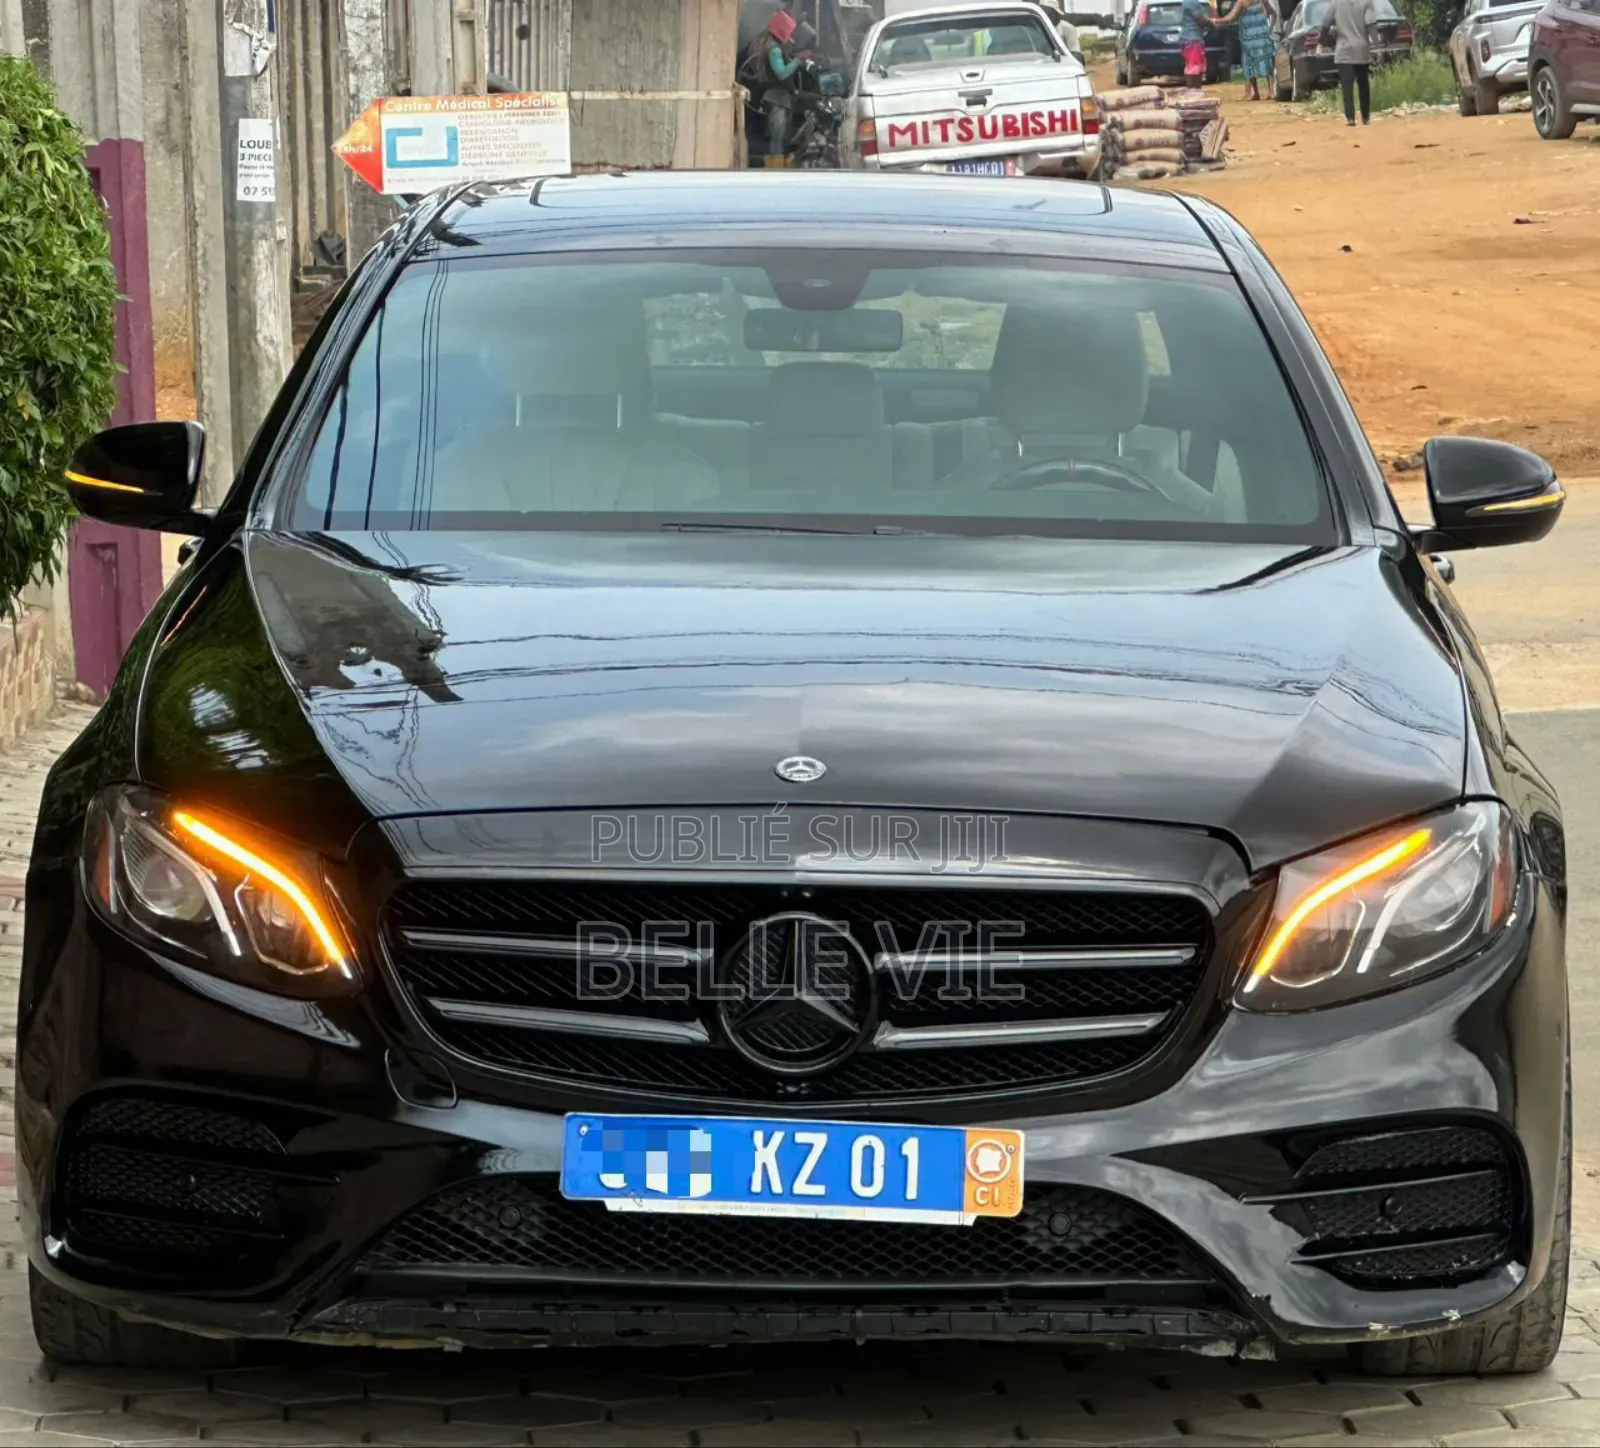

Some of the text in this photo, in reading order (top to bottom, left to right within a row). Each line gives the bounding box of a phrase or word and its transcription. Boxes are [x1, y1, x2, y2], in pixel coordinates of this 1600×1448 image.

[384, 100, 433, 113] Centre
[436, 97, 491, 111] Médical
[888, 108, 1079, 148] MITSUBISHI
[750, 1130, 828, 1195] KZ
[850, 1133, 920, 1200] 01
[975, 1186, 1000, 1207] CI
